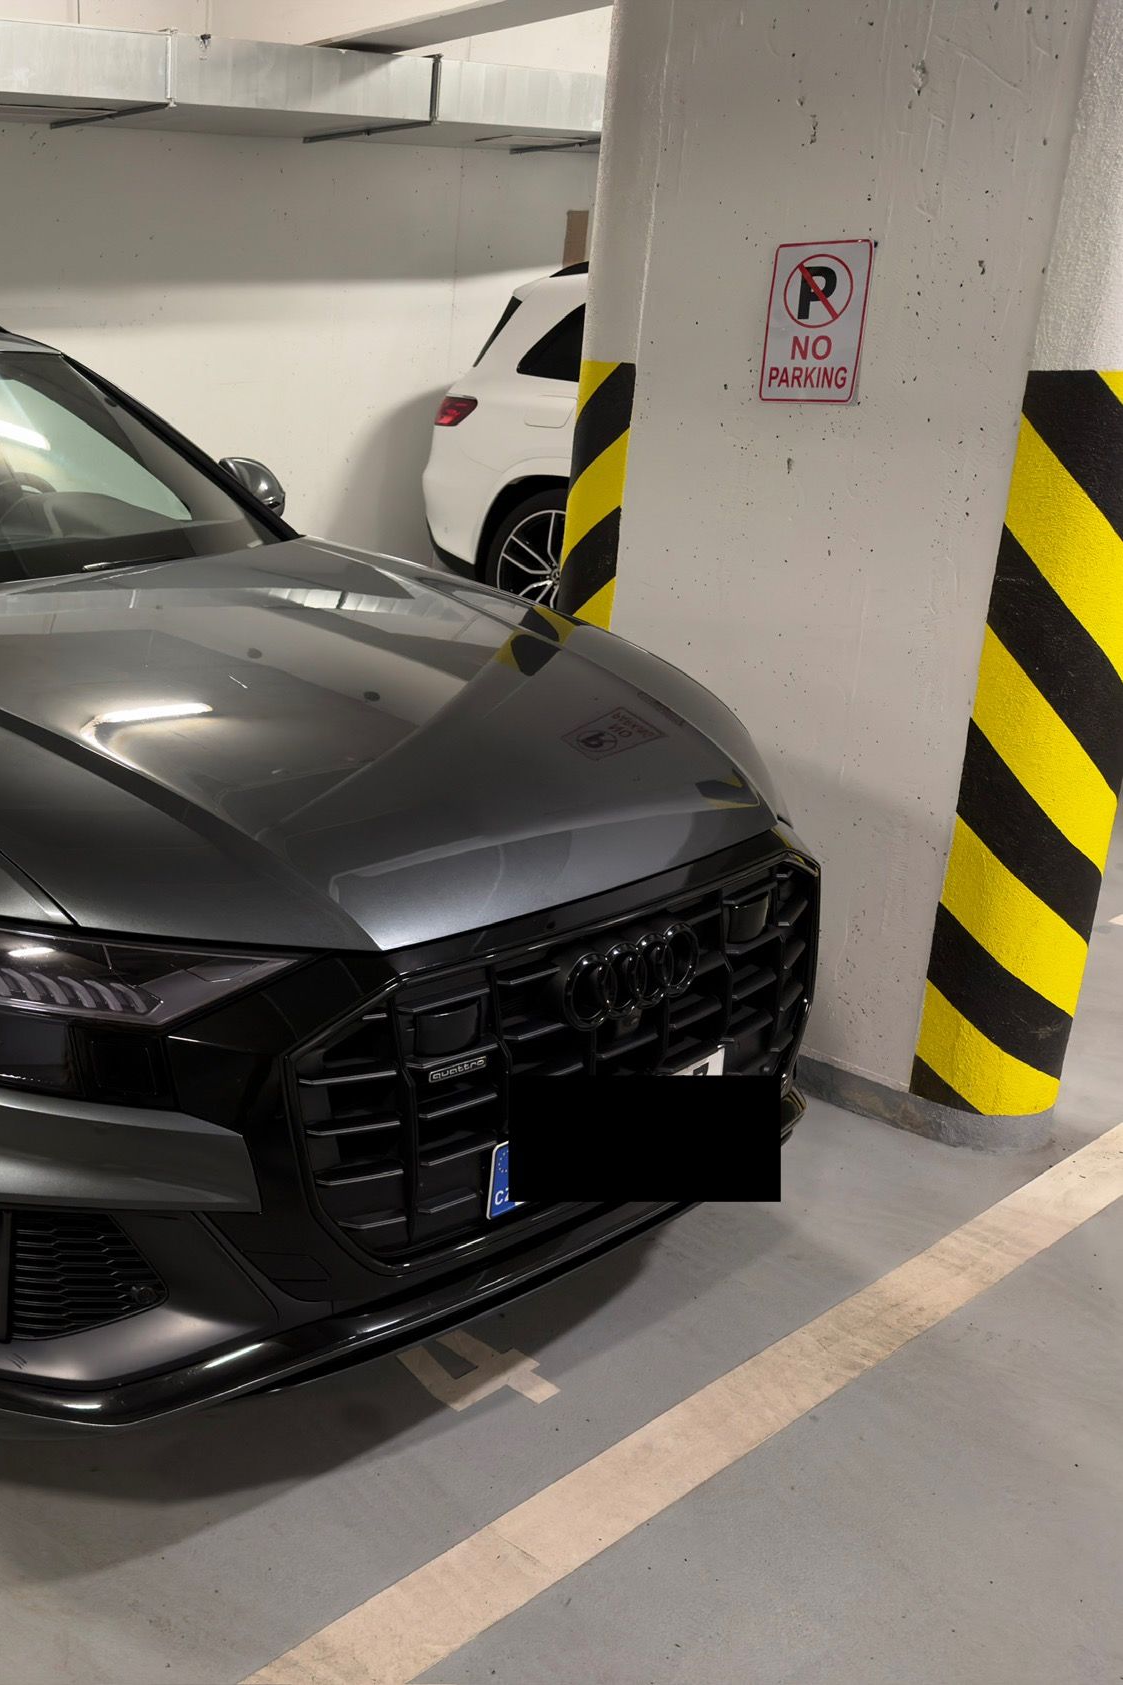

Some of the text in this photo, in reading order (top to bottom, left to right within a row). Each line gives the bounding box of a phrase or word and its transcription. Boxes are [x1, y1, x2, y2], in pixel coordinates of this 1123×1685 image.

[797, 266, 837, 319] P
[790, 335, 832, 360] NO
[767, 366, 848, 389] PARKING
[432, 1060, 485, 1080] quattro
[396, 1329, 561, 1412] 4
